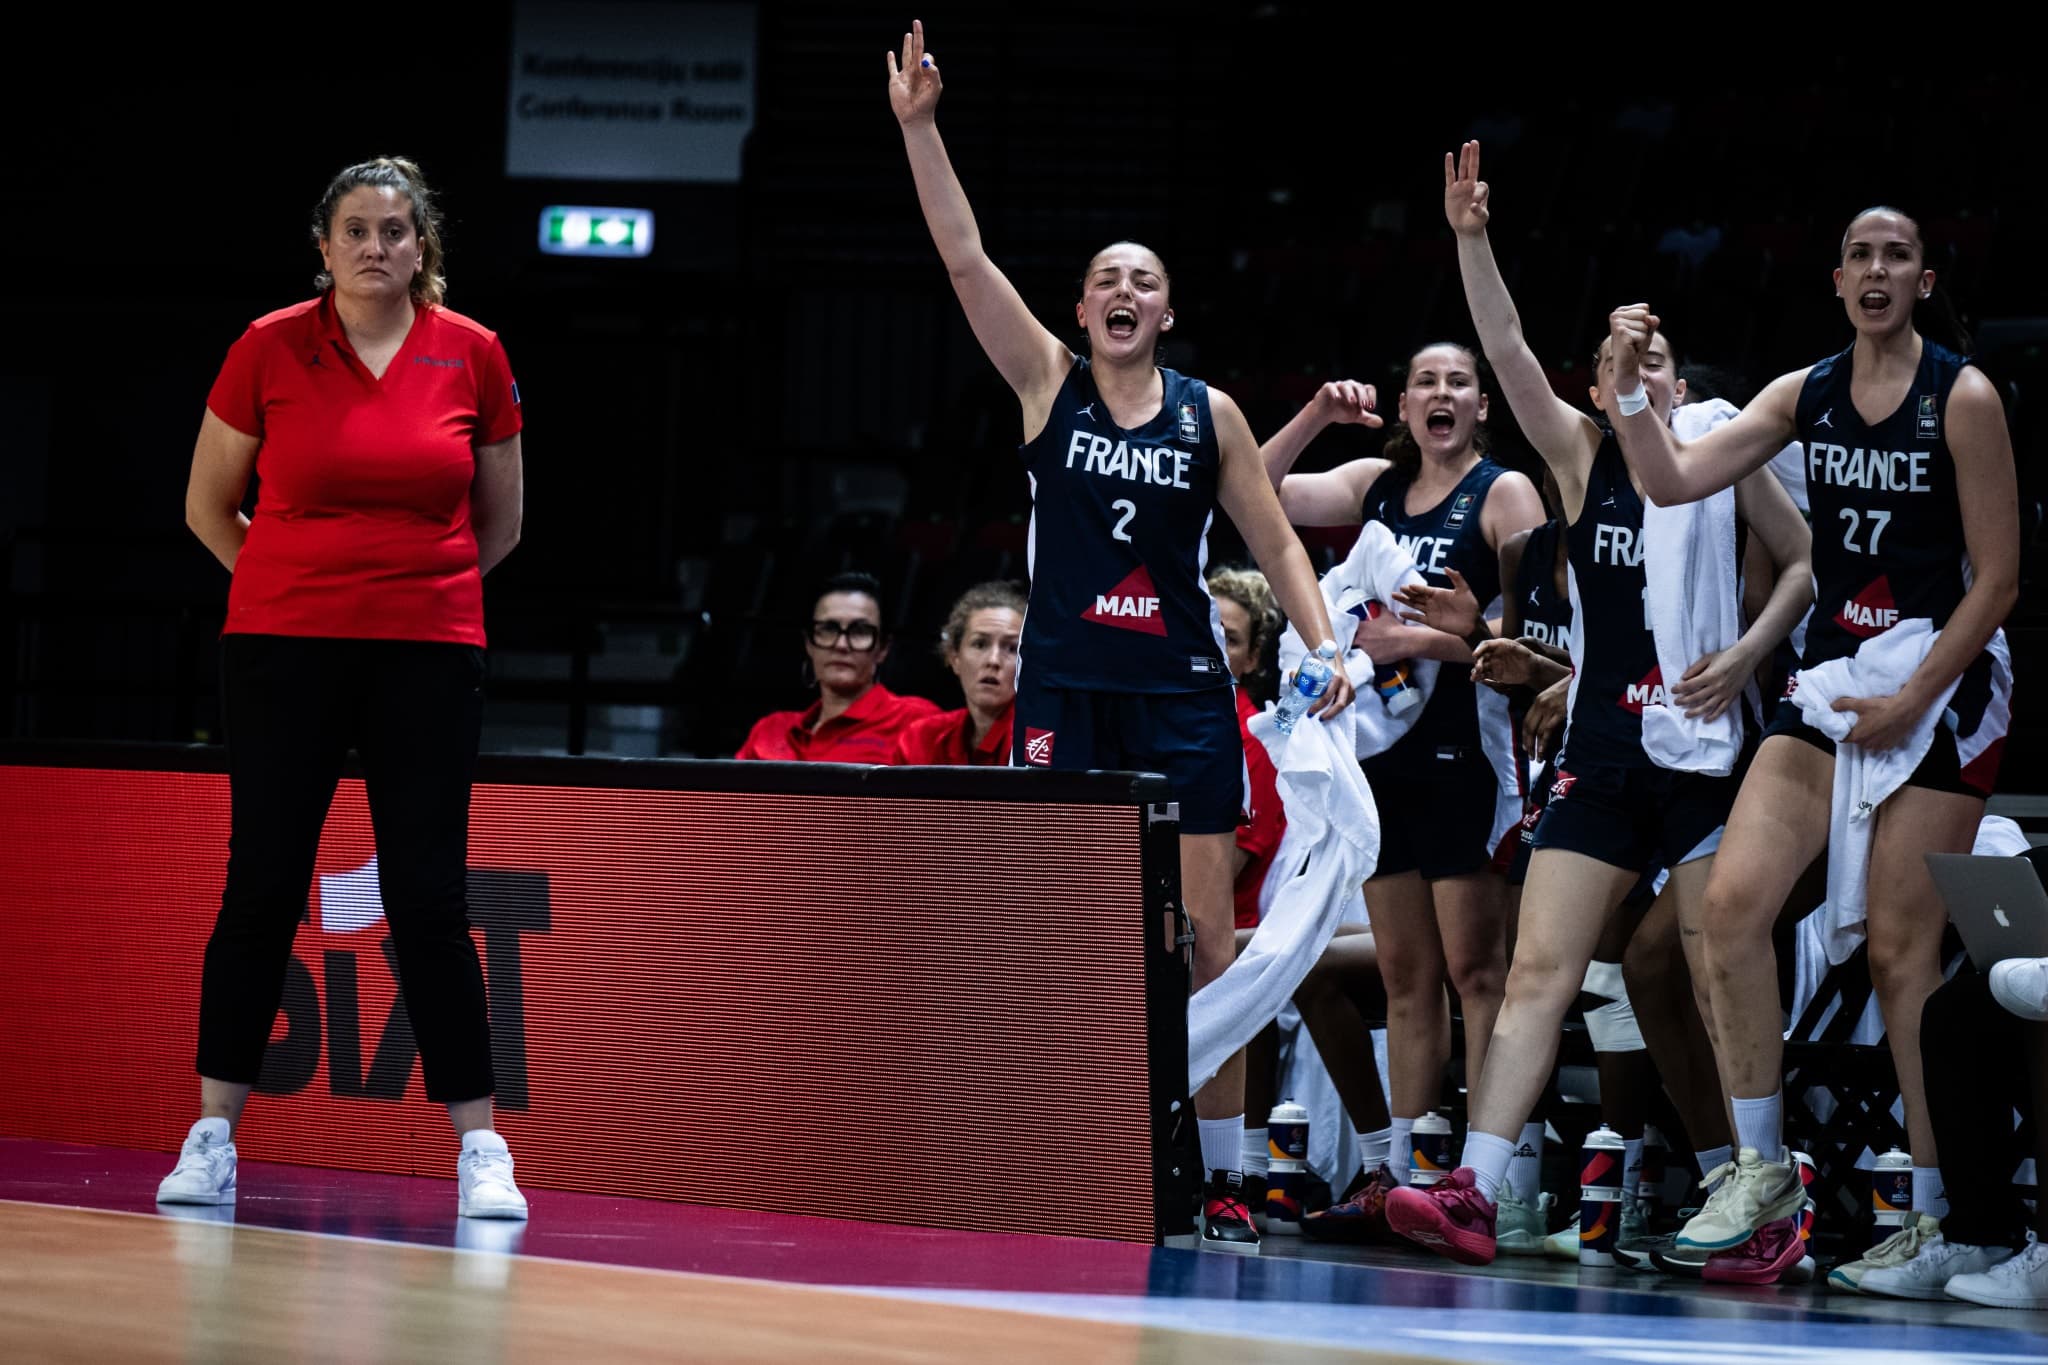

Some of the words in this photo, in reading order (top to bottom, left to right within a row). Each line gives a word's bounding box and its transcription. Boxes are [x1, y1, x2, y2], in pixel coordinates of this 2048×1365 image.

[1065, 430, 1192, 490] FRANCE
[1809, 442, 1931, 493] FRANCE
[1111, 499, 1137, 544] 2
[1839, 507, 1891, 555] 27
[1392, 533, 1454, 575] NCE
[1593, 522, 1645, 567] FRA
[1095, 594, 1160, 618] MAIF
[1843, 599, 1900, 628] MAIF
[1523, 619, 1572, 650] FRAN
[1626, 683, 1666, 705] MA
